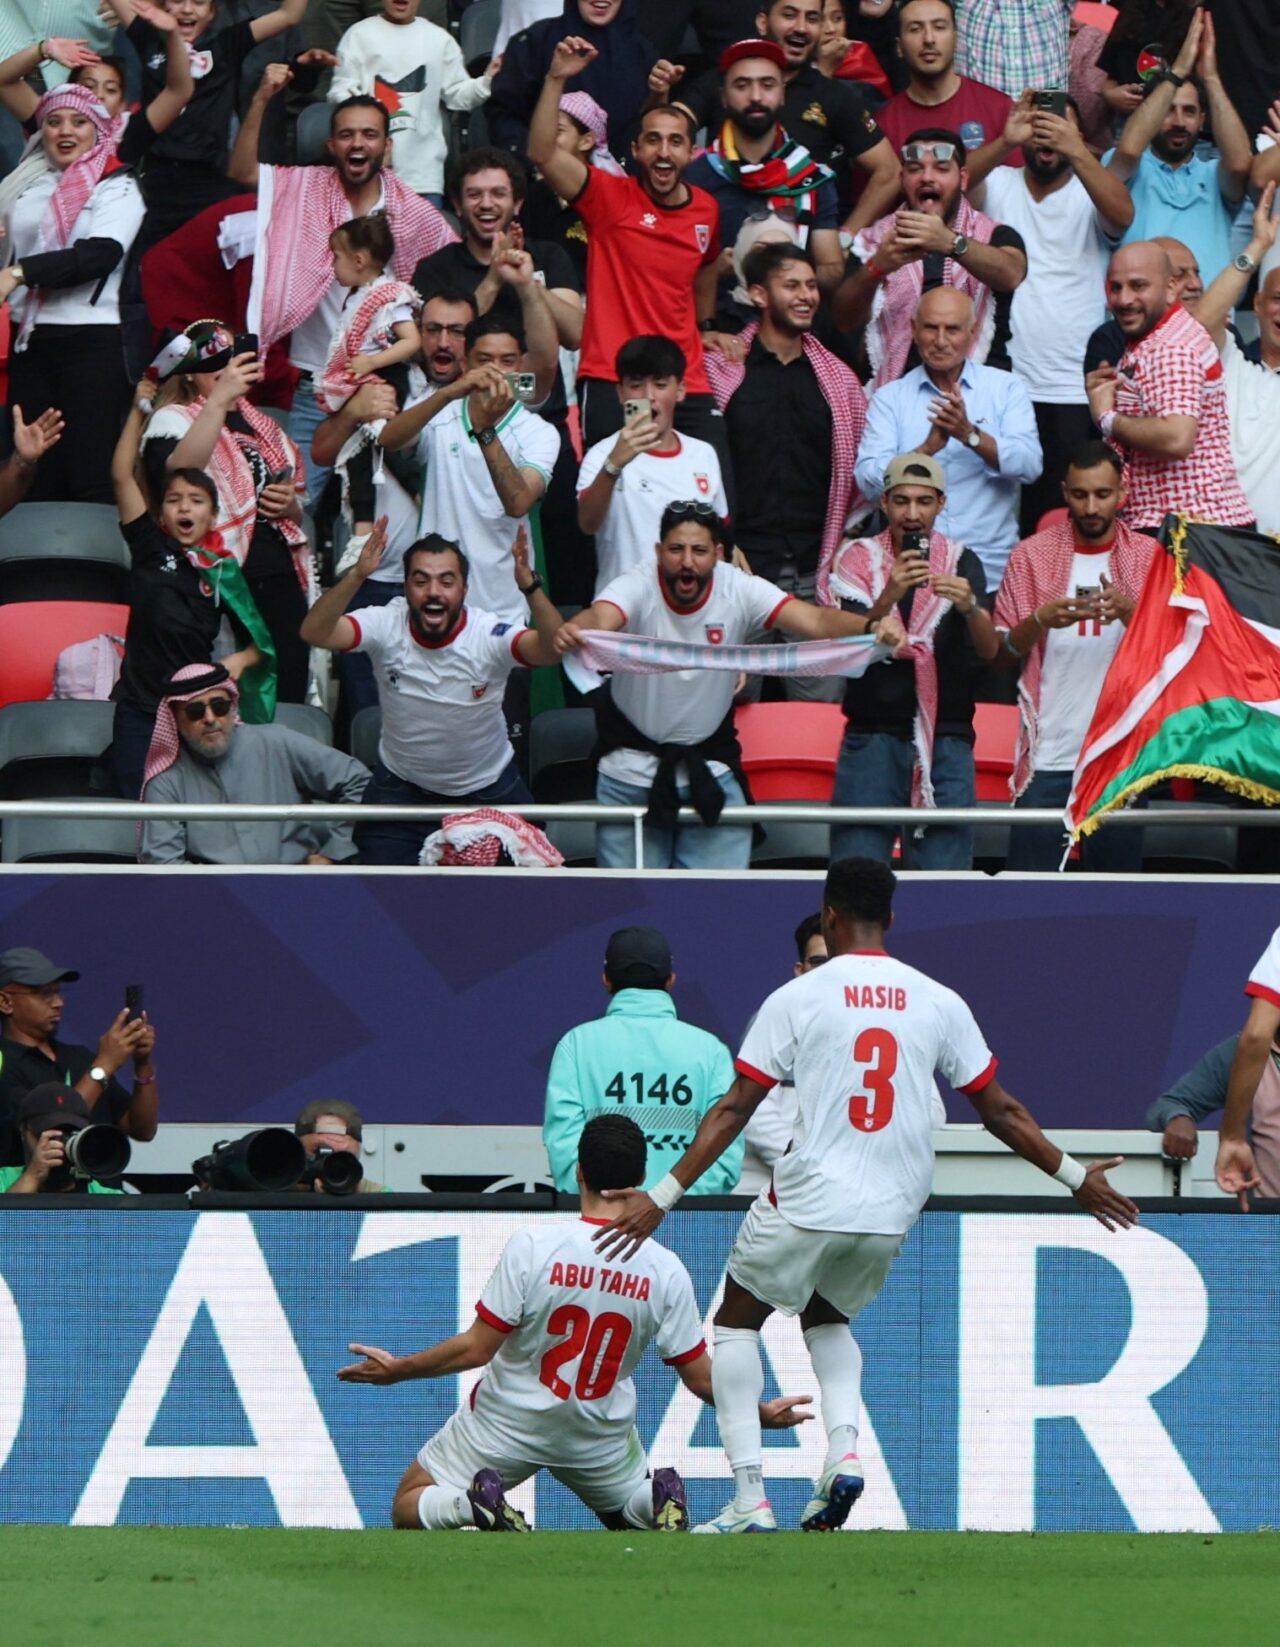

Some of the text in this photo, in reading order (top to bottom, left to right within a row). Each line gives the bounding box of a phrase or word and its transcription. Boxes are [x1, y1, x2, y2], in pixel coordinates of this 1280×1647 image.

[844, 985, 907, 1011] NASIB
[604, 1071, 694, 1107] 4146
[849, 1027, 900, 1133] 3
[550, 1262, 651, 1302] ABU TAHA
[0, 1211, 1222, 1532] ATAR
[538, 1304, 632, 1401] 20
